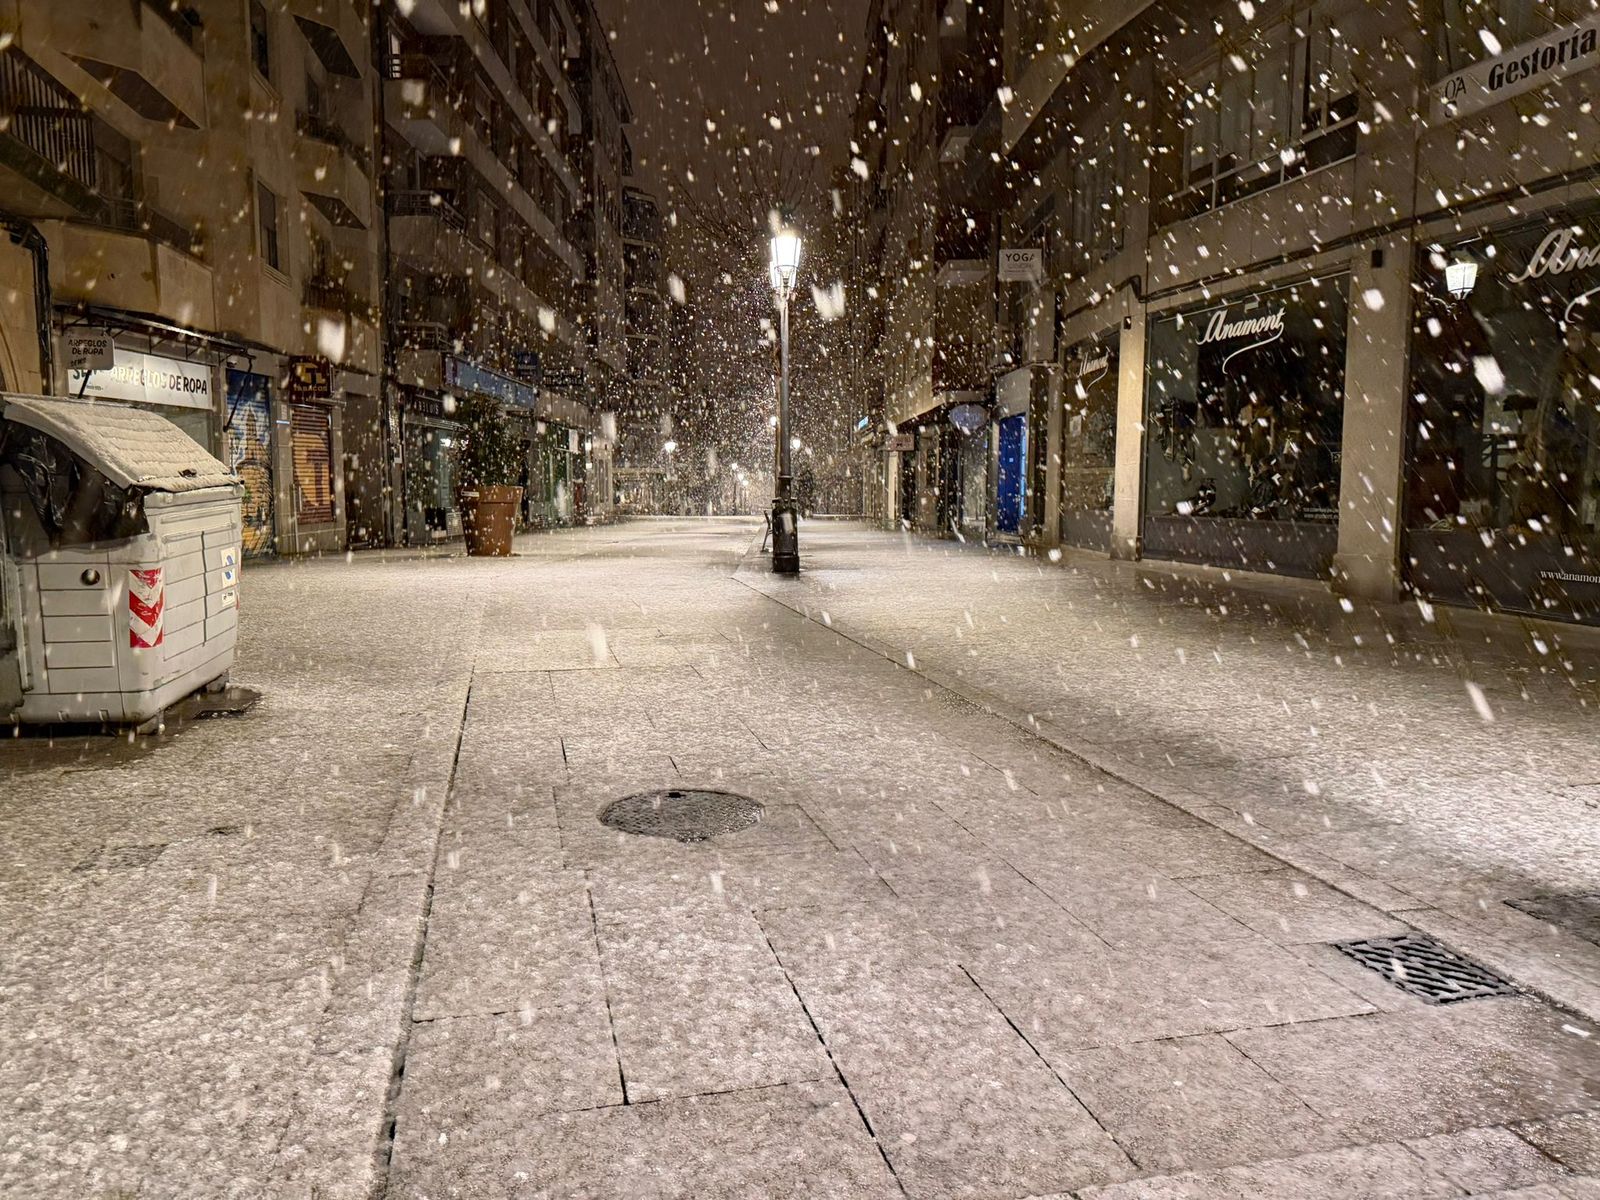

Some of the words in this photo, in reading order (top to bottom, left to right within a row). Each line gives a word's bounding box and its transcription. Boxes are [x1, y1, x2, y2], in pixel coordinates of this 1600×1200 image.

[1489, 28, 1597, 91] Gestoría
[1005, 252, 1036, 262] YOGA
[1195, 307, 1286, 346] Anamont
[71, 347, 82, 355] DE
[83, 348, 104, 356] ROPA
[112, 366, 167, 389] ARREGLOS
[169, 374, 181, 391] DE
[183, 376, 208, 395] ROPA
